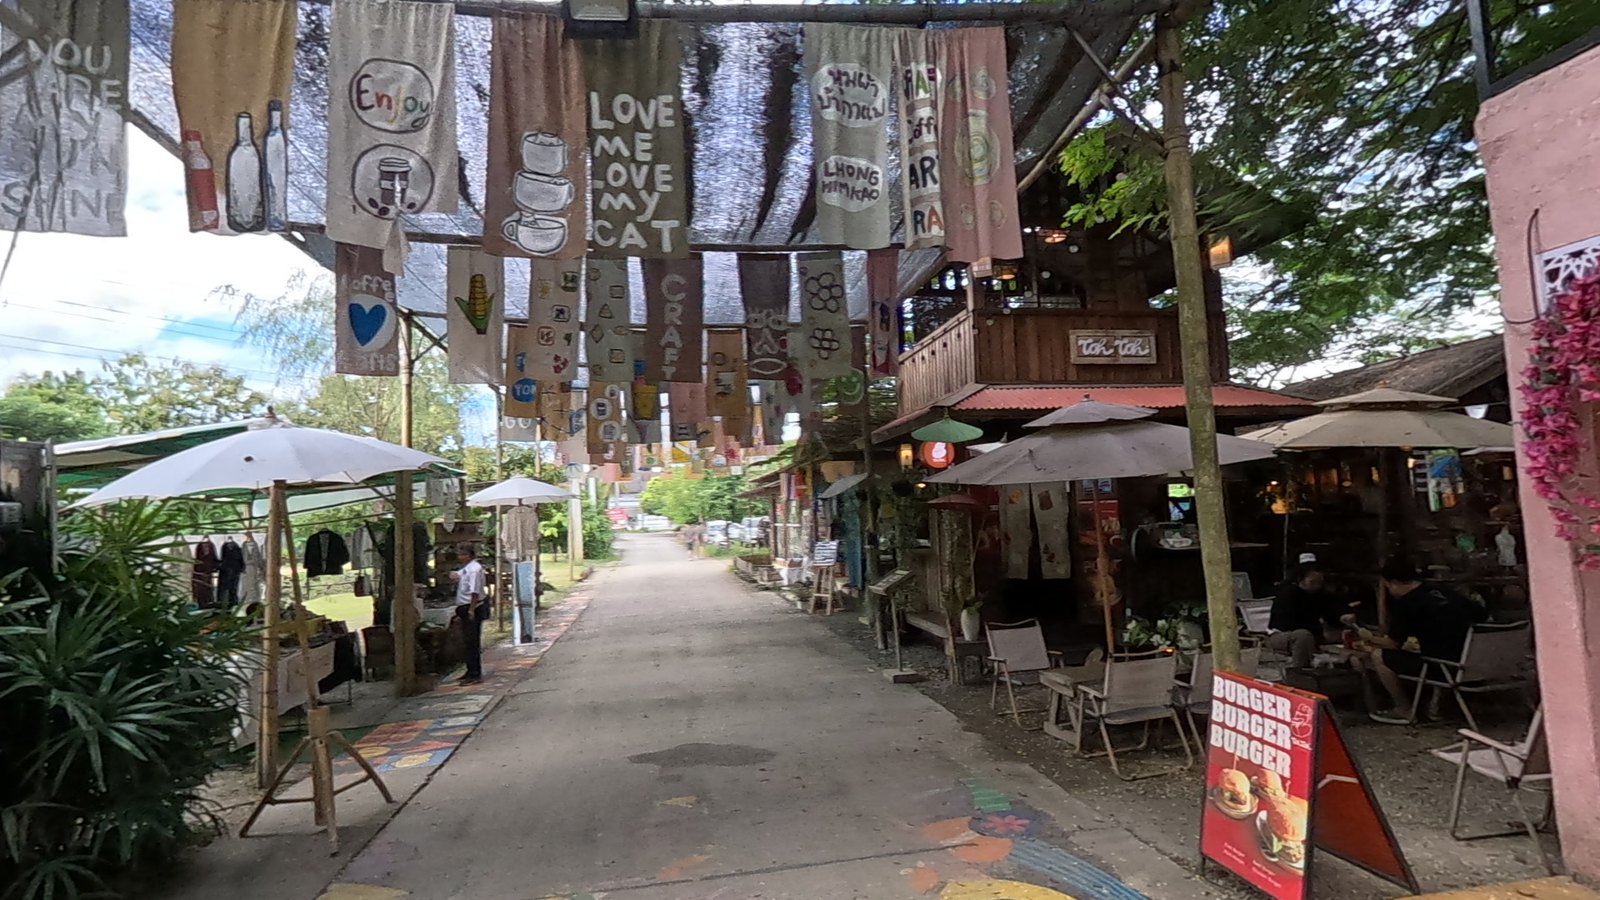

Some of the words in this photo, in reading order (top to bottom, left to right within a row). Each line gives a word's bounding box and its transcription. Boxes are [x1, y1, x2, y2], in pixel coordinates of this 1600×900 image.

[28, 38, 112, 75] YOU
[356, 73, 430, 129] Enjoy
[590, 91, 675, 130] LOVE
[594, 132, 653, 161] ME
[823, 161, 880, 187] LHONG
[593, 220, 680, 252] CAT
[660, 273, 687, 381] CRAFT
[1213, 674, 1292, 723] BURGER
[1211, 698, 1292, 751] BURGER
[1210, 723, 1292, 779] BURGER
